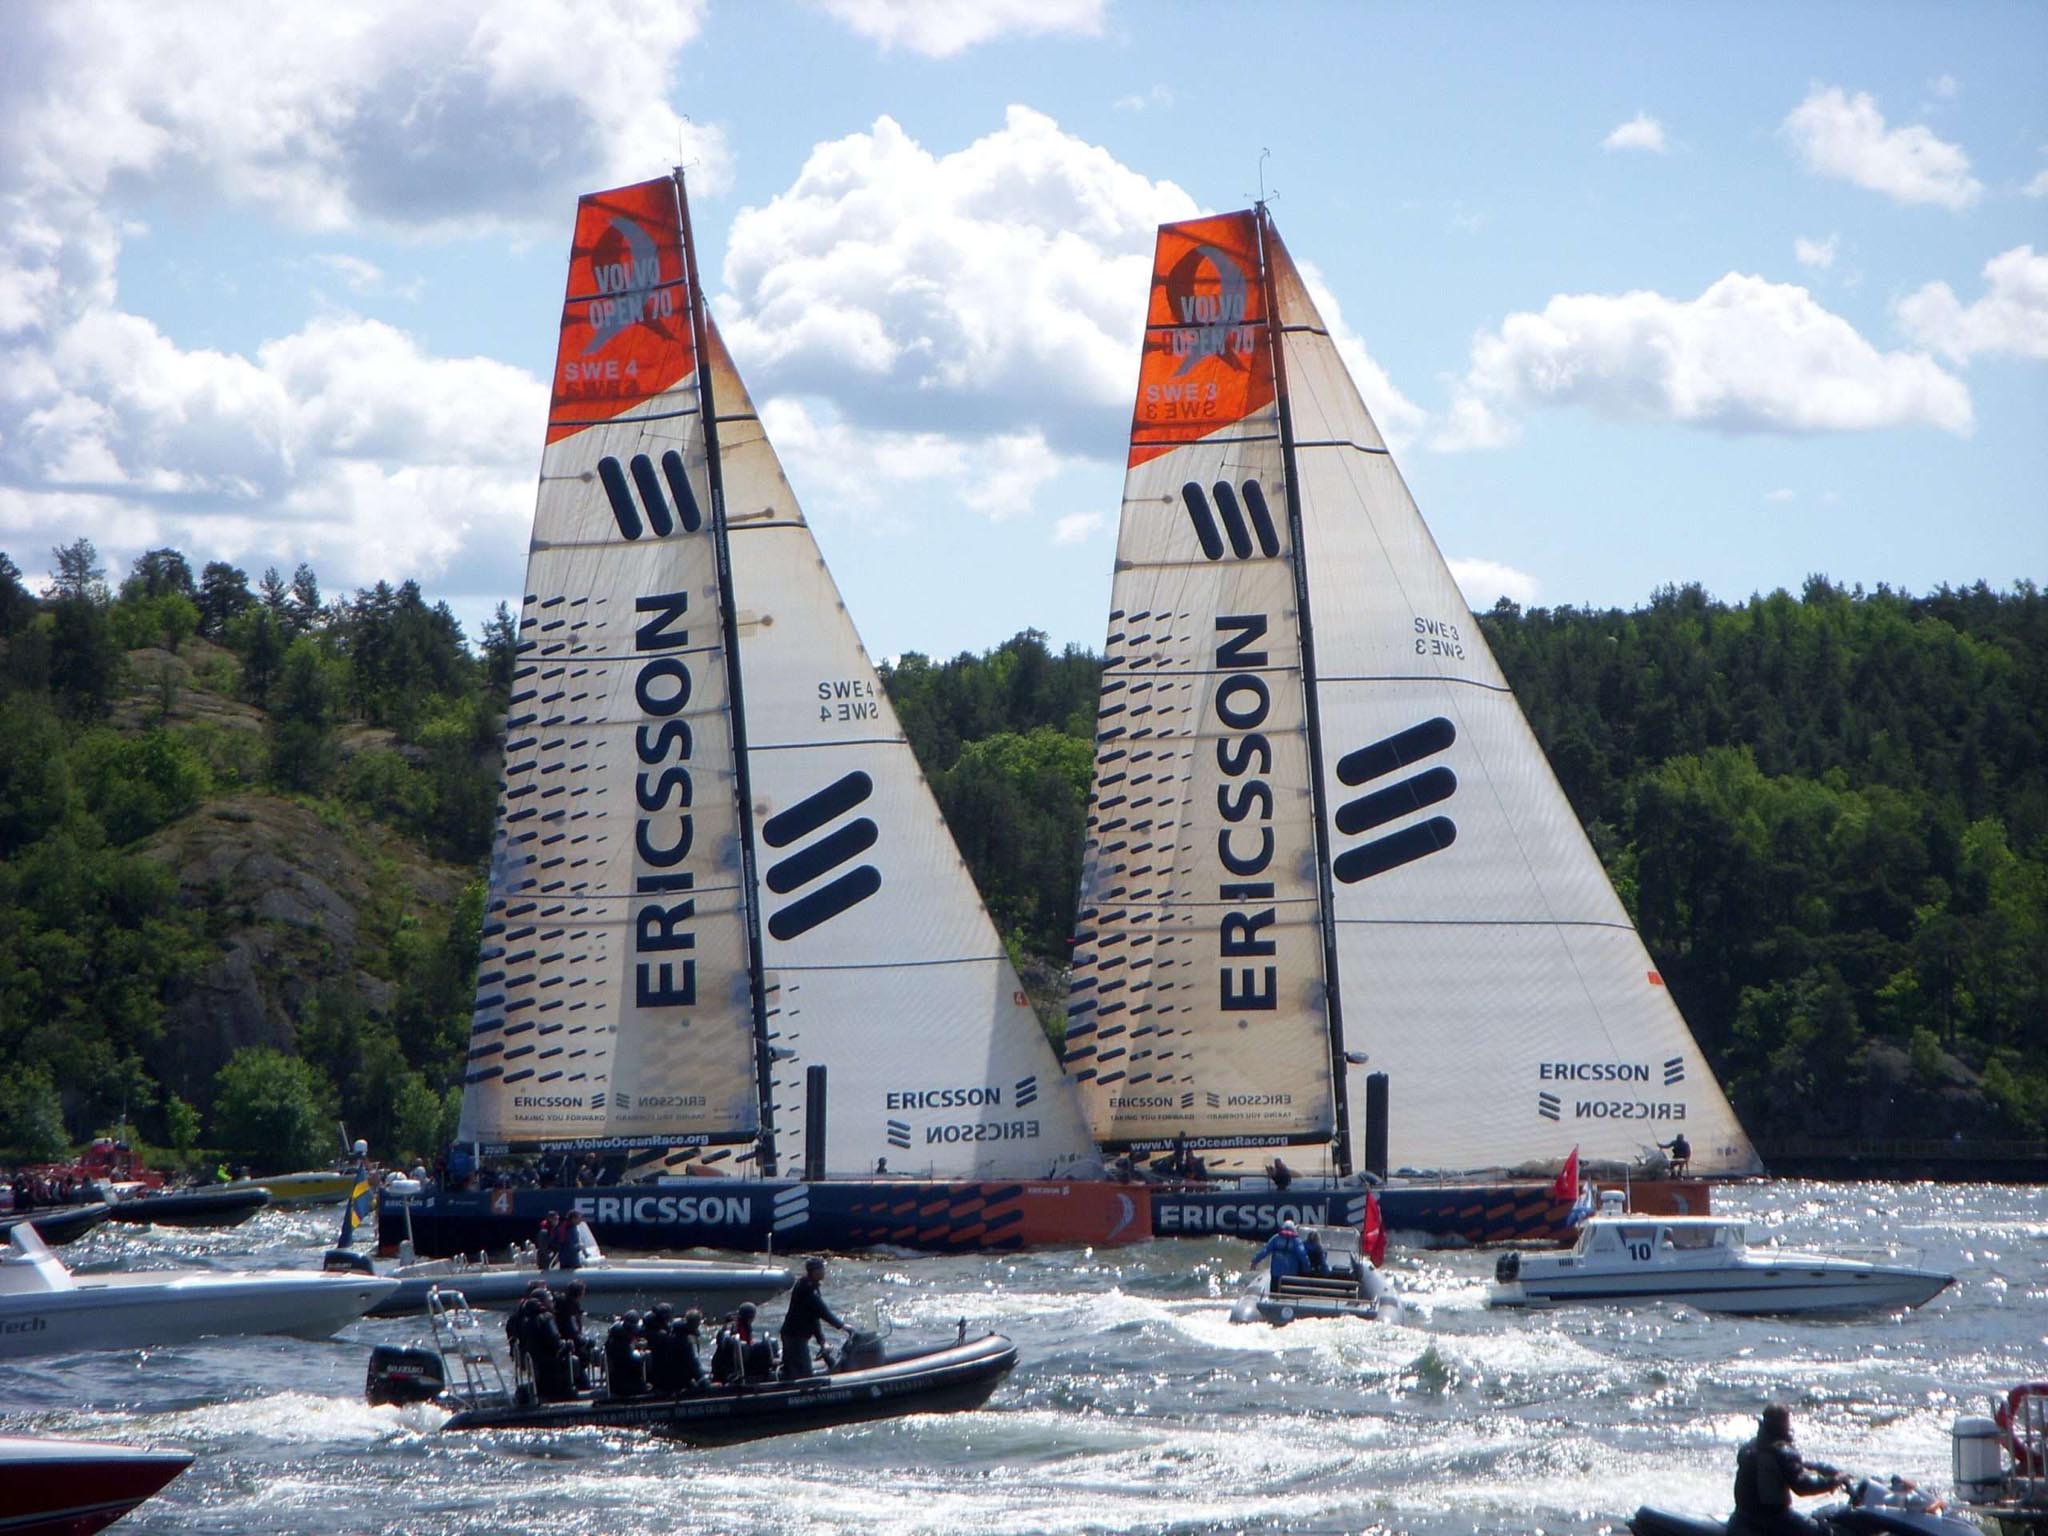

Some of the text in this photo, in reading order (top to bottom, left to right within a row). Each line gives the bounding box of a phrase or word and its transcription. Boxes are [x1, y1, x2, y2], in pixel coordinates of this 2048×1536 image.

[595, 258, 660, 293] VOLVO
[590, 288, 672, 329] OPEN 70
[1181, 295, 1246, 322] VOLVO
[1173, 326, 1225, 357] OPEN
[565, 359, 639, 380] SWE 4
[1146, 383, 1199, 401] SWE
[1414, 618, 1459, 640] SWE 3
[818, 681, 874, 700] SWE 4
[636, 591, 696, 1008] ERICSSON
[1215, 614, 1277, 1011] ERICSSON
[1539, 1063, 1649, 1081] ERICSSON
[514, 1096, 583, 1108] ERICSSON
[887, 1088, 1001, 1110] ERICSSON
[1109, 1096, 1173, 1108] ERICSSON
[540, 1135, 709, 1150] www.VolvoOceanRace.org
[1130, 1135, 1288, 1151] www.VvoOceanRace.org
[495, 1193, 511, 1212] 4
[574, 1197, 751, 1225] ERICSSON
[1160, 1204, 1327, 1230] ERICSSON
[1627, 1243, 1651, 1261] 10
